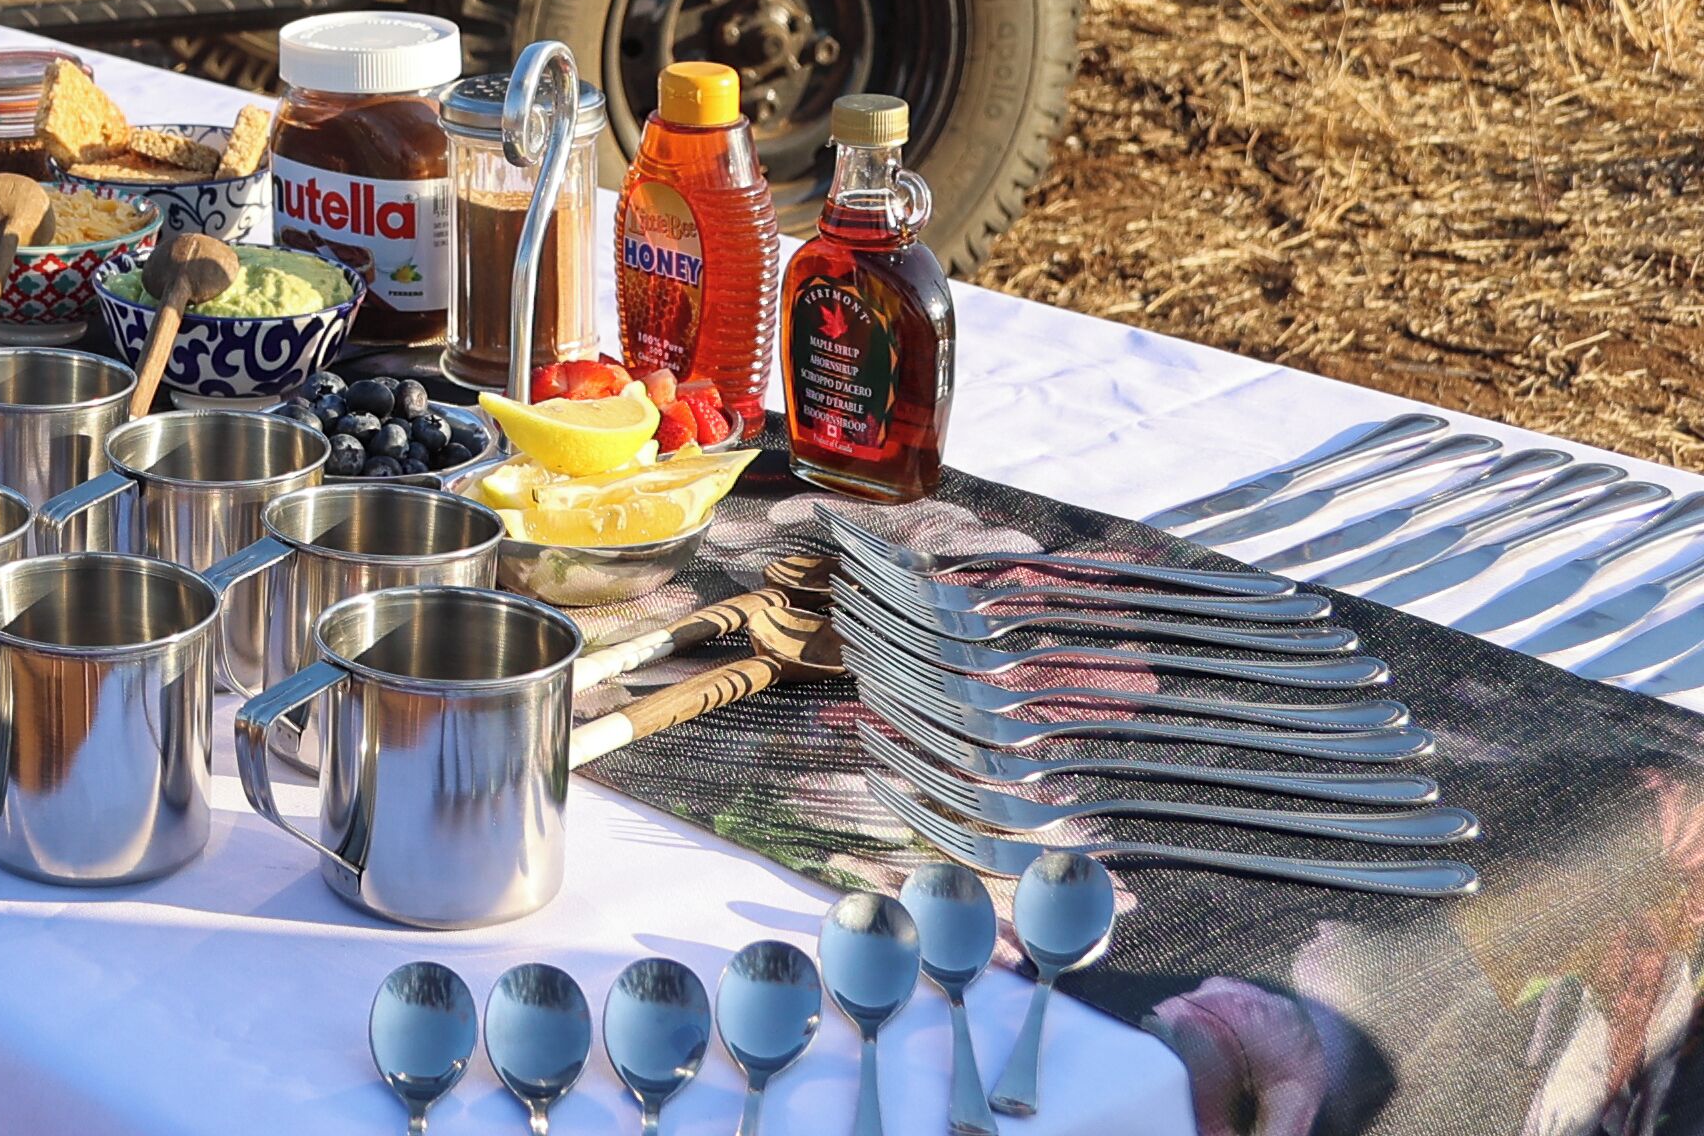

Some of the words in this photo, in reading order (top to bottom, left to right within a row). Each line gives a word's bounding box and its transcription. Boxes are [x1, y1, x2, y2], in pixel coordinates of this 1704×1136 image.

[624, 237, 702, 288] HONEY
[388, 289, 425, 298] FERRERO
[804, 288, 870, 322] VERTMONT
[638, 331, 662, 347] 100%
[663, 339, 684, 354] Pure
[809, 335, 834, 353] MAPLE
[834, 343, 860, 359] SYRUP
[809, 354, 859, 376] AHORNSIRUP
[800, 367, 835, 390] SCIROPPO
[835, 380, 873, 398] D'ACERO
[805, 387, 826, 404] SIROP
[835, 441, 853, 454] Canada
